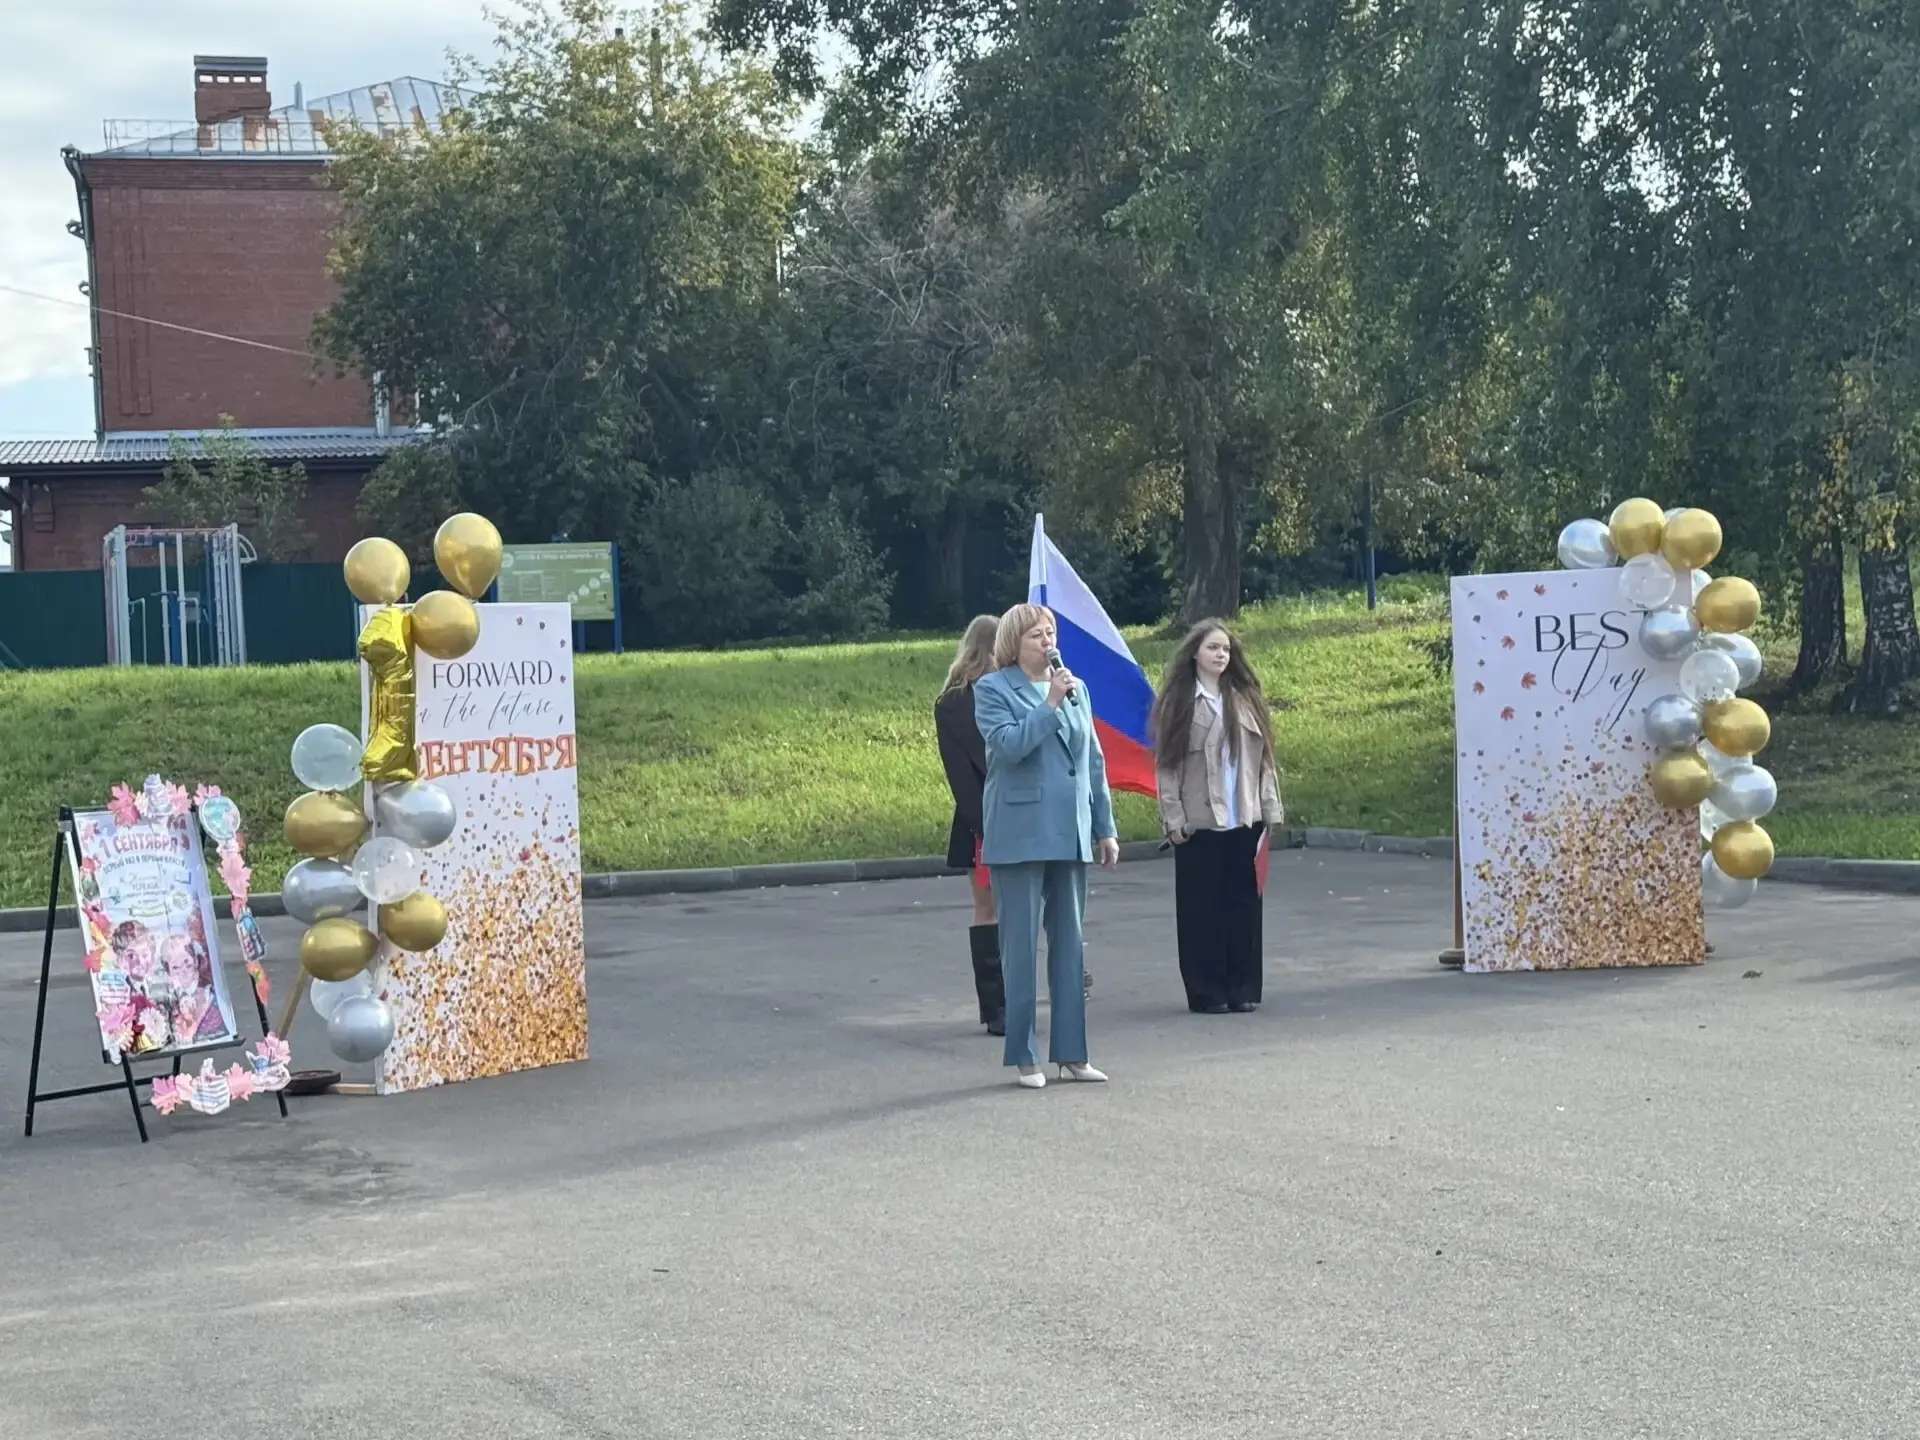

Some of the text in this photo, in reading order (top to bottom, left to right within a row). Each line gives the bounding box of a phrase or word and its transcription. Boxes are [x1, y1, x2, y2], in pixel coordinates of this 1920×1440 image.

[433, 660, 553, 689] FORWARD
[1552, 633, 1651, 734] Day
[443, 691, 479, 728] the
[487, 690, 554, 731] future
[99, 832, 178, 858] 1 СЕНТЯБРЯ
